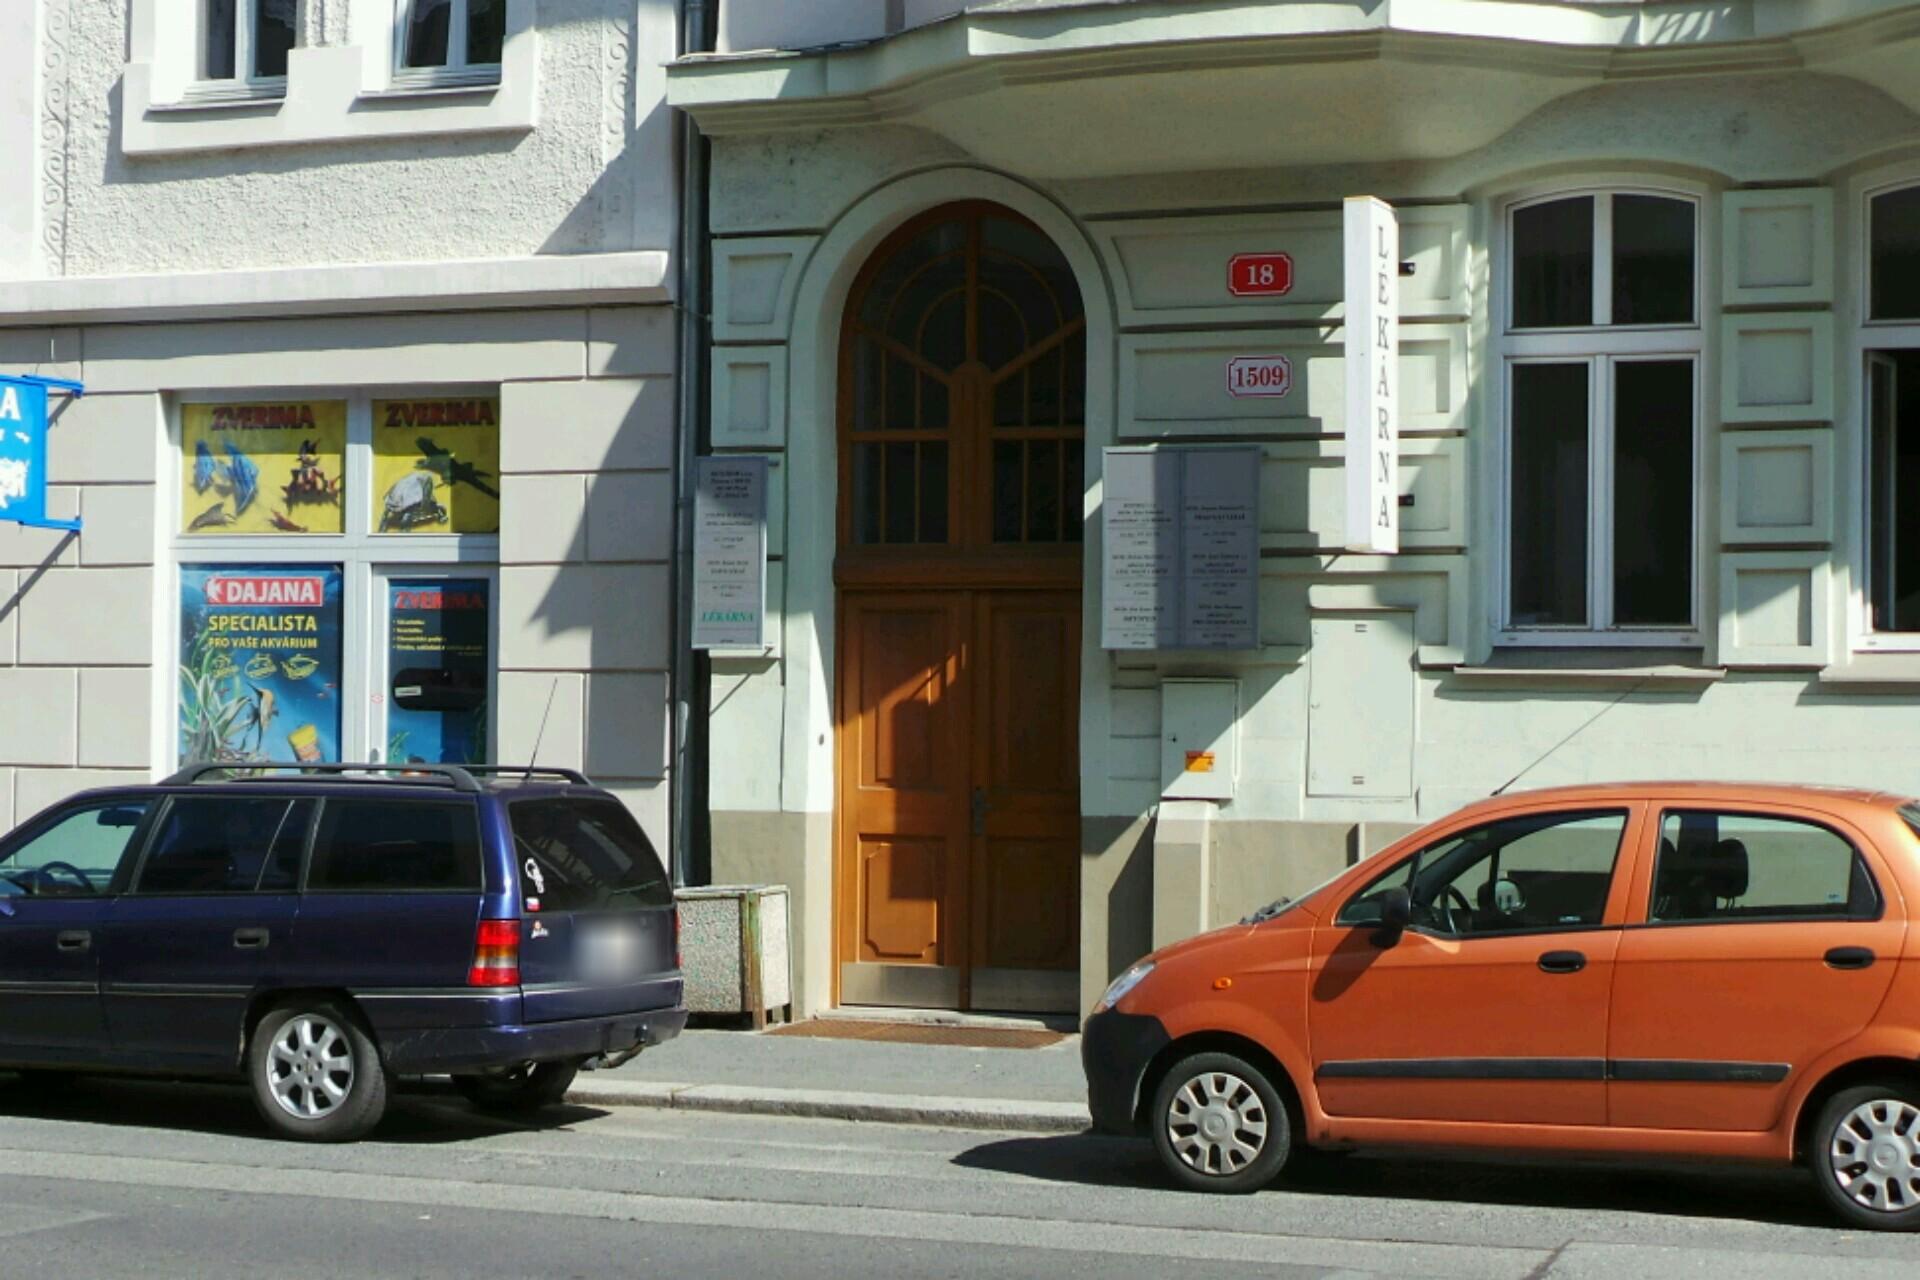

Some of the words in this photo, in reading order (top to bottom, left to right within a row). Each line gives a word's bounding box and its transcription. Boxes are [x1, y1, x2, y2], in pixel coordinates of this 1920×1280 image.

[1247, 264, 1275, 286] 18
[1234, 365, 1285, 388] 1509
[226, 580, 316, 603] DAJANA
[208, 615, 318, 632] SPECIALISTA
[208, 637, 230, 649] PRO
[231, 635, 258, 649] VAŠE
[259, 635, 318, 649] AKVÁRIUM
